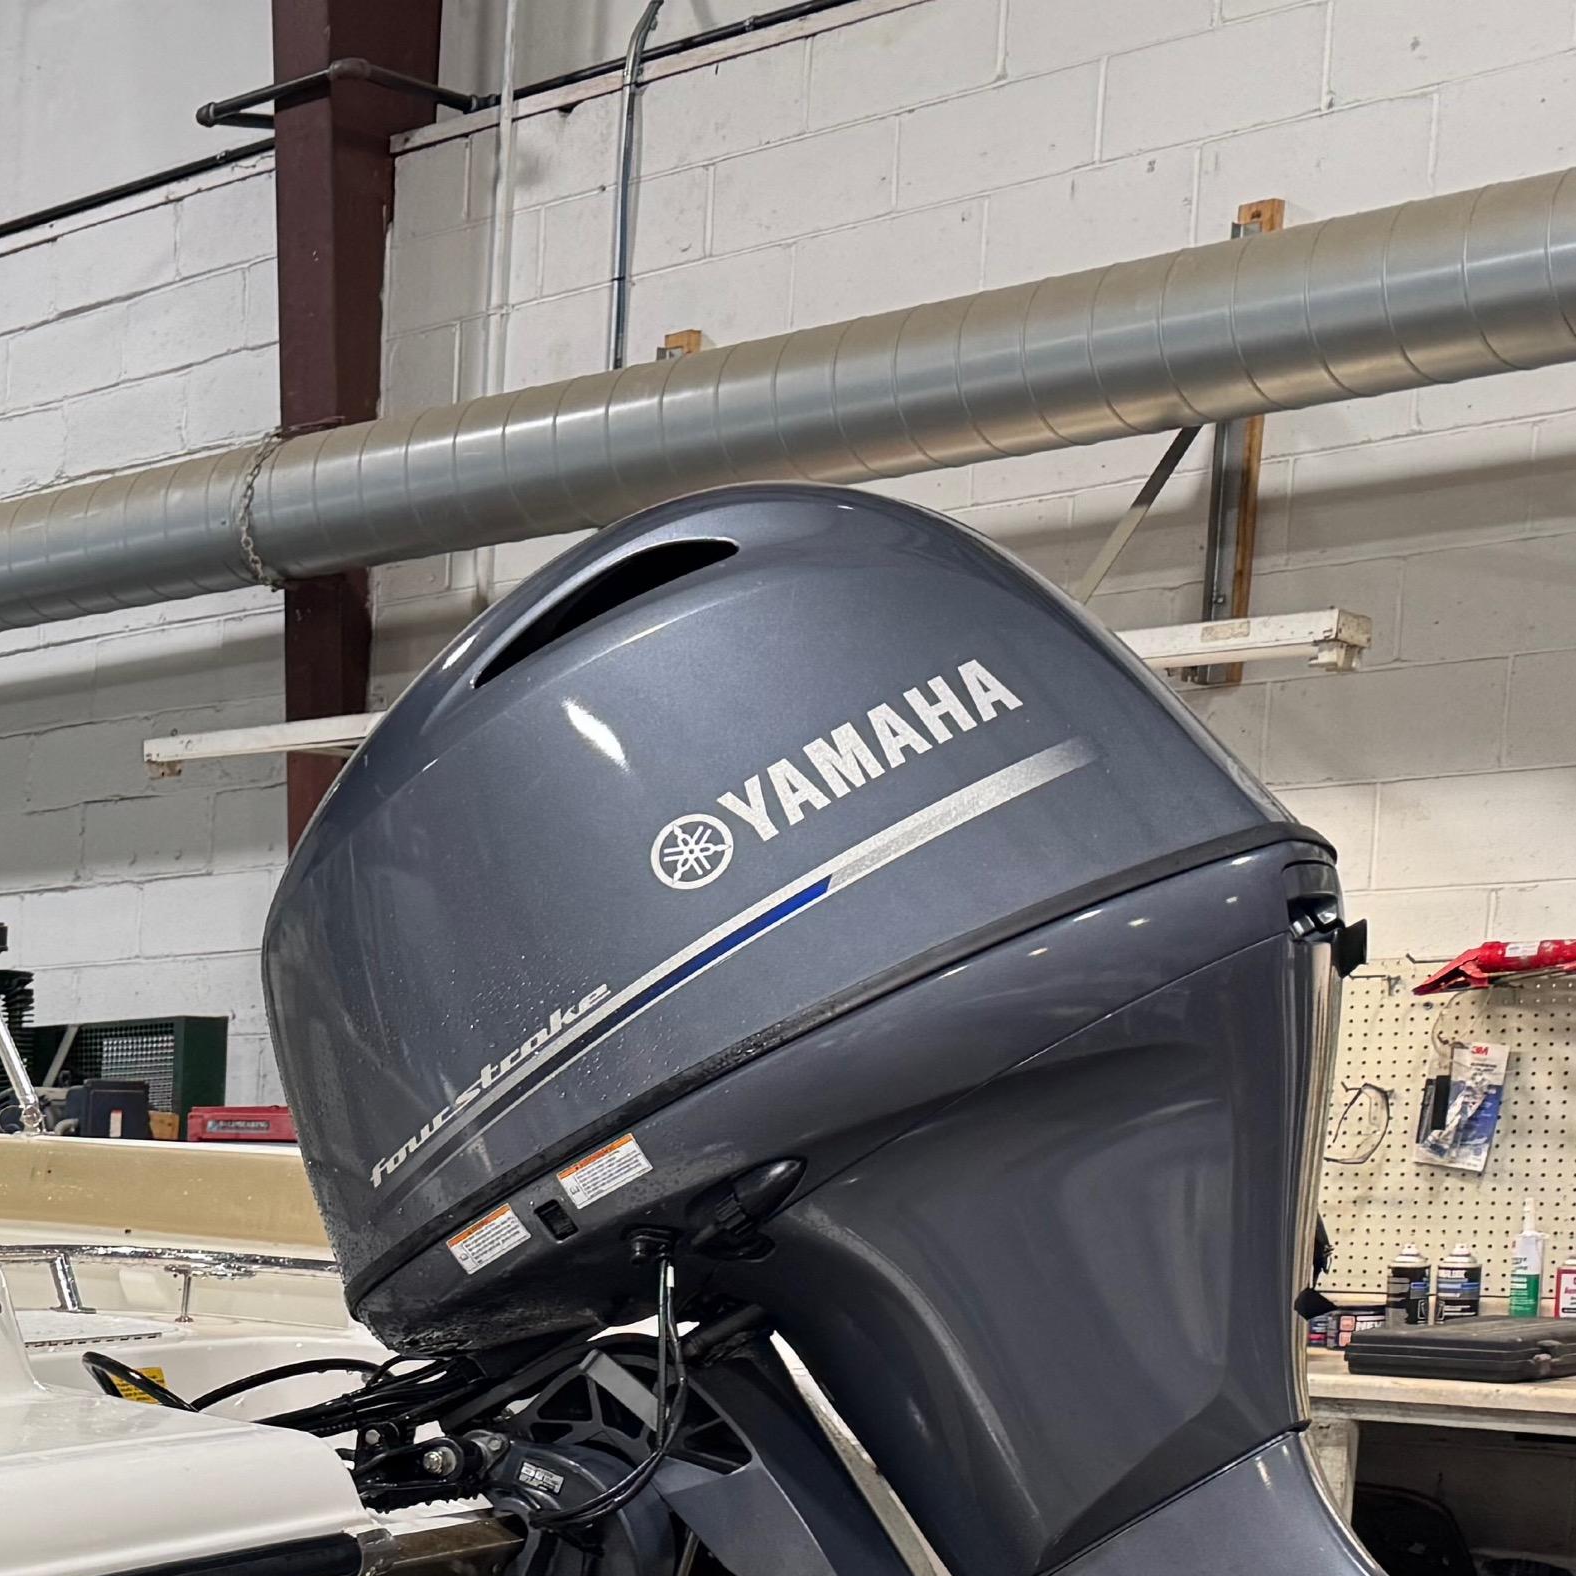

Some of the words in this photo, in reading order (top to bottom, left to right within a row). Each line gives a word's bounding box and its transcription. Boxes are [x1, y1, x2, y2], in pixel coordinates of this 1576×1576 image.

[716, 658, 1024, 842] YAMAHA
[370, 983, 612, 1190] fourstroke
[1471, 1046, 1489, 1056] 3M
